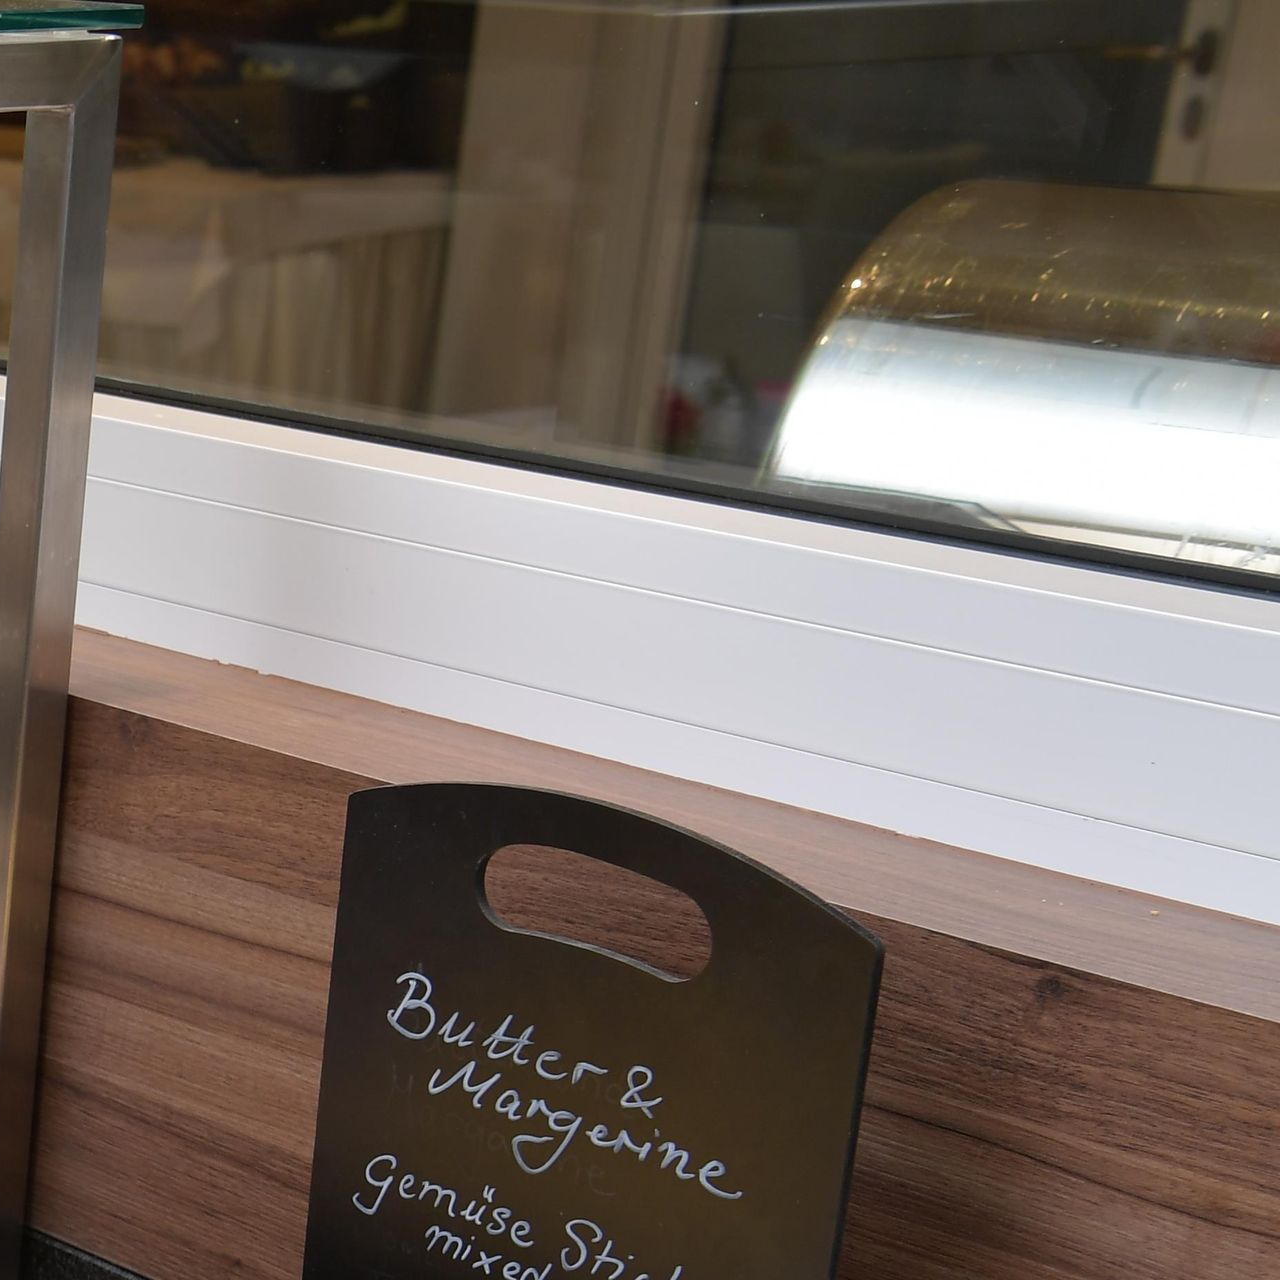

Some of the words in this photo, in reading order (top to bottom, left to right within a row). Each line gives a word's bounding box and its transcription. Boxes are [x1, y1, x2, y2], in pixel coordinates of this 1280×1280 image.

[386, 971, 609, 1085] Butter
[618, 1065, 663, 1119] &
[427, 1060, 743, 1200] Margerine
[351, 1154, 535, 1248] Gemüse
